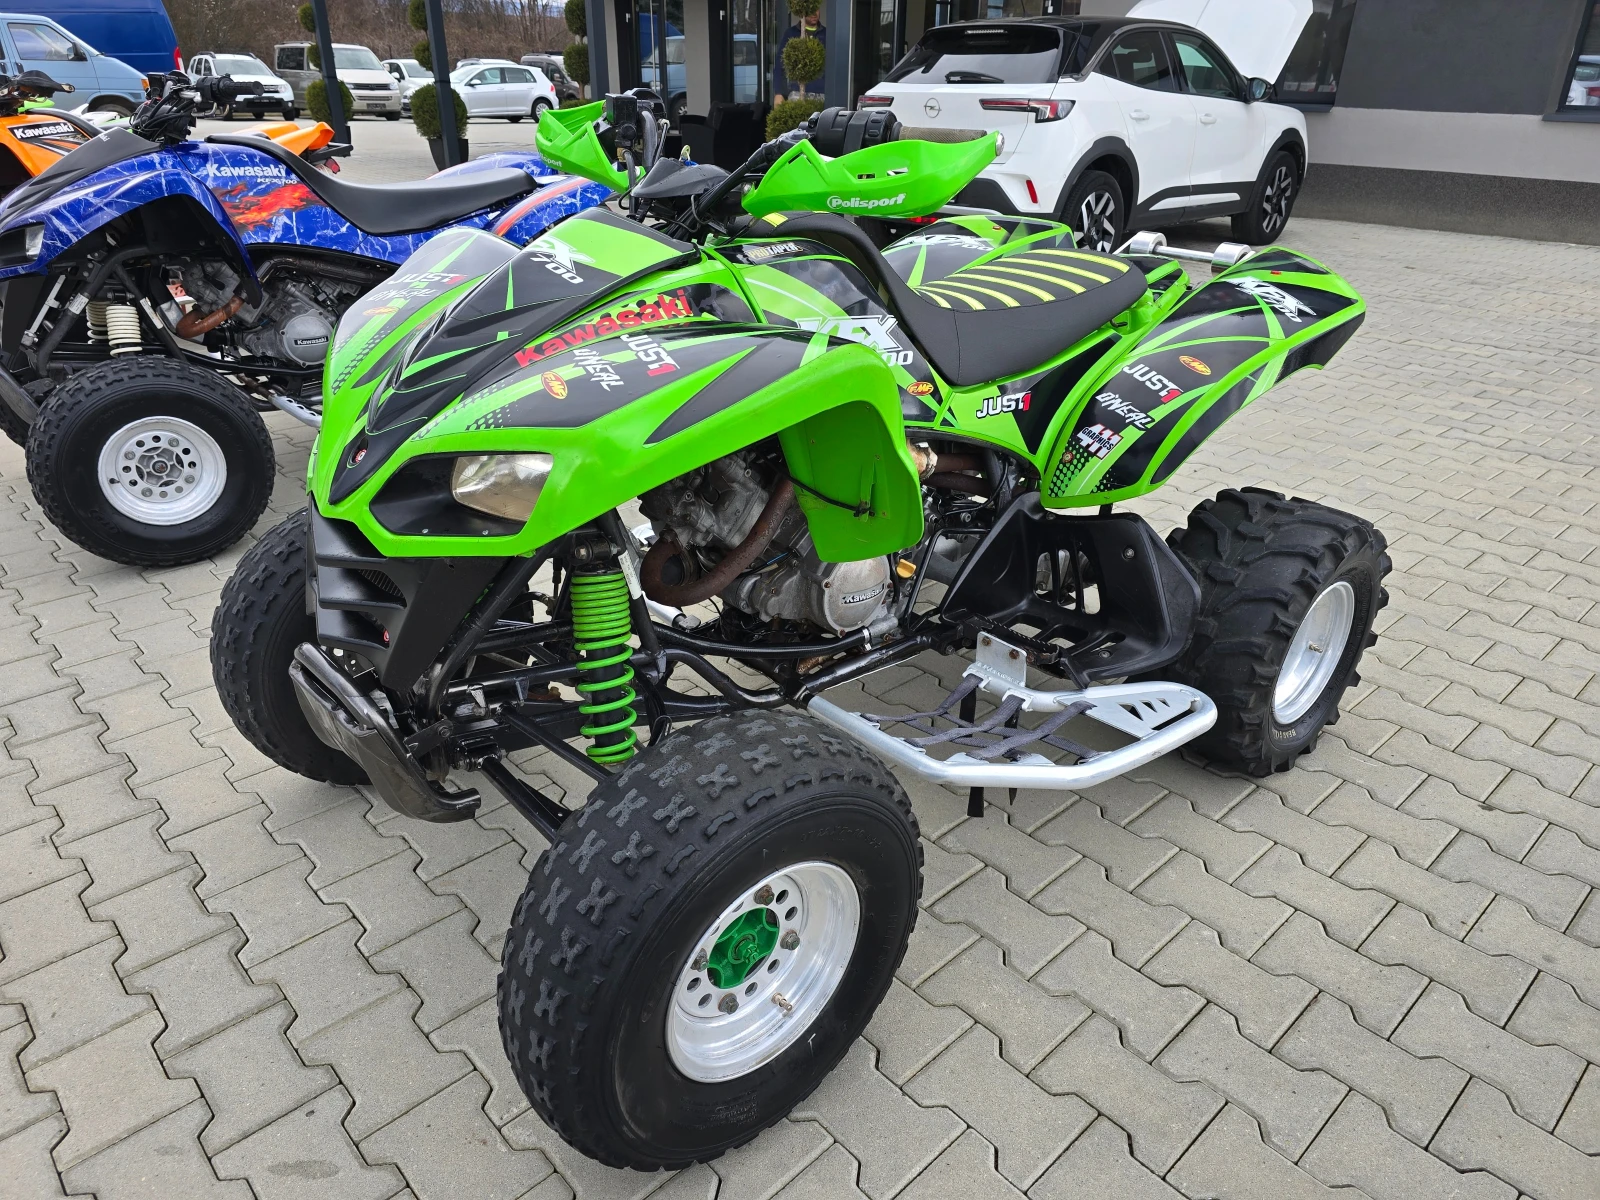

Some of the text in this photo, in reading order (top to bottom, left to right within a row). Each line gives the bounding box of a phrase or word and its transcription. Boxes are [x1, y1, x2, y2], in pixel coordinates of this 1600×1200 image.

[13, 123, 75, 139] Kawasaki
[206, 163, 286, 177] Kawasaki
[827, 193, 906, 209] Polisport
[530, 253, 584, 284] 700
[297, 337, 327, 345] Kawasaki
[514, 289, 693, 368] Kawasaki
[619, 334, 681, 377] JUST1
[880, 350, 914, 367] 00
[542, 371, 568, 399] FMF
[908, 383, 933, 395] FMF
[1122, 363, 1184, 404] JUST1
[976, 390, 1032, 419] JUST1
[1081, 427, 1115, 452] GRAPHICS
